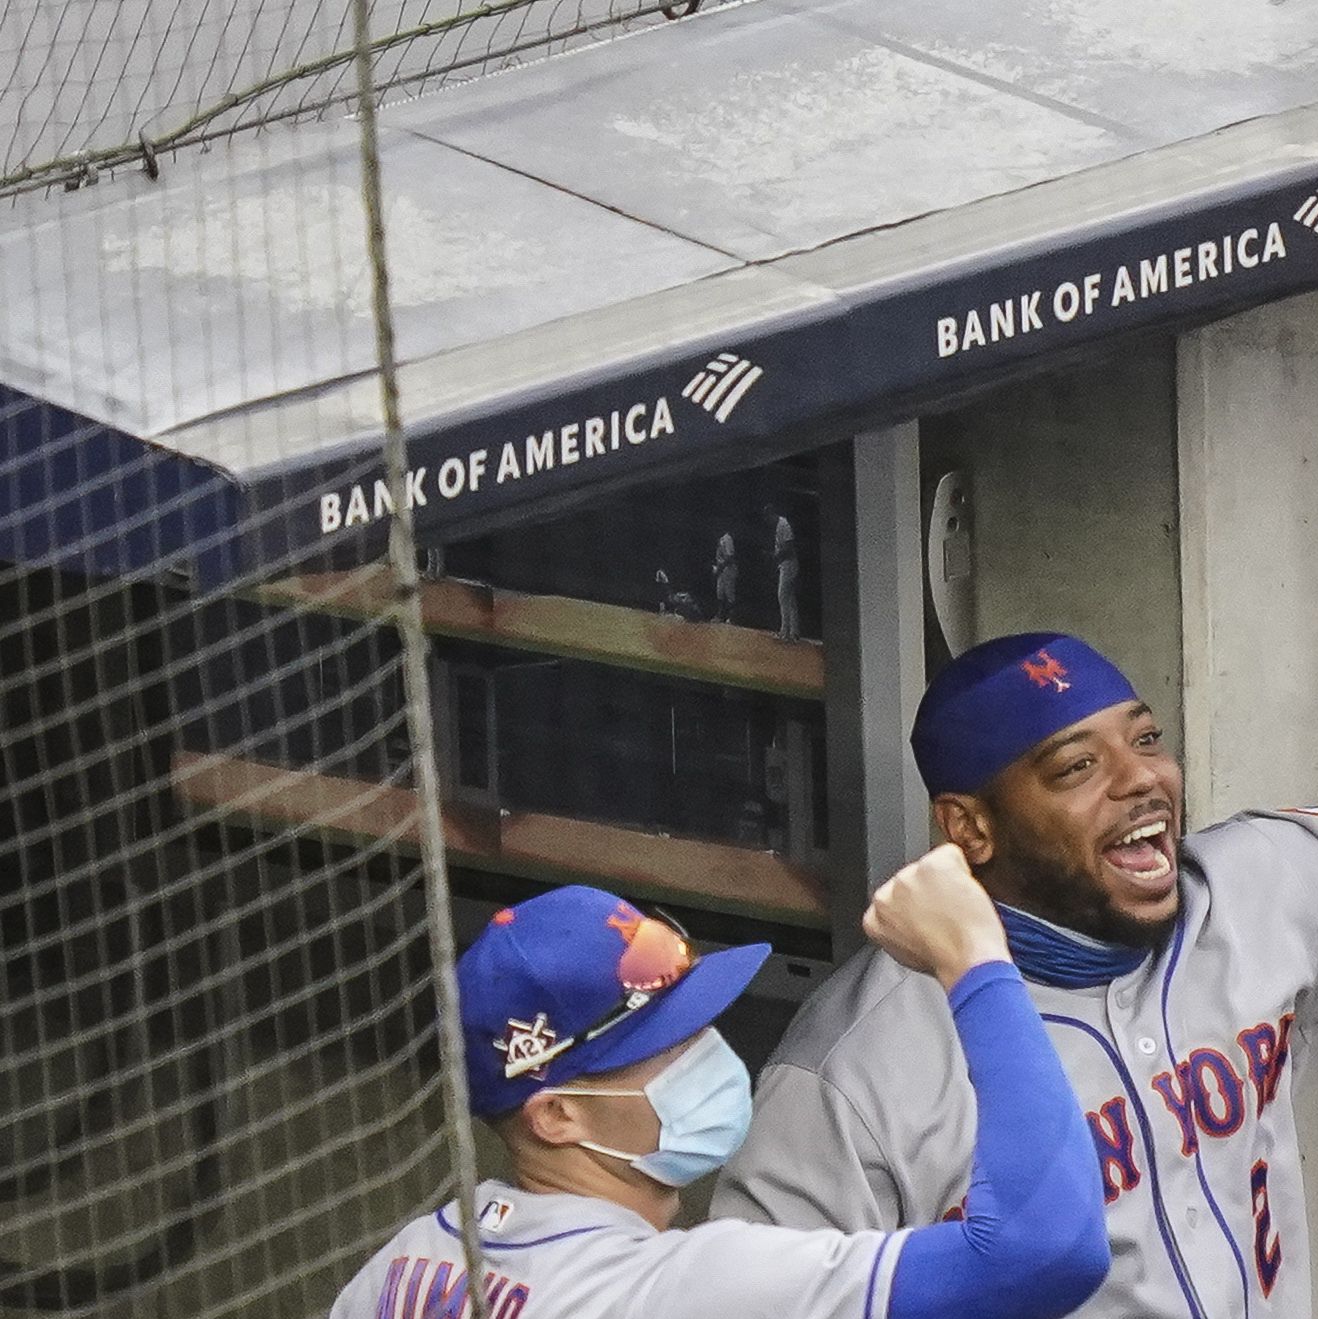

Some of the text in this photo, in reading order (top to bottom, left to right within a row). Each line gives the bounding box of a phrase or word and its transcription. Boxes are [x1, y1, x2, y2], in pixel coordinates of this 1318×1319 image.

[936, 223, 1287, 359] BANK OF AMERICA
[320, 396, 675, 535] BANK OF AMERICA
